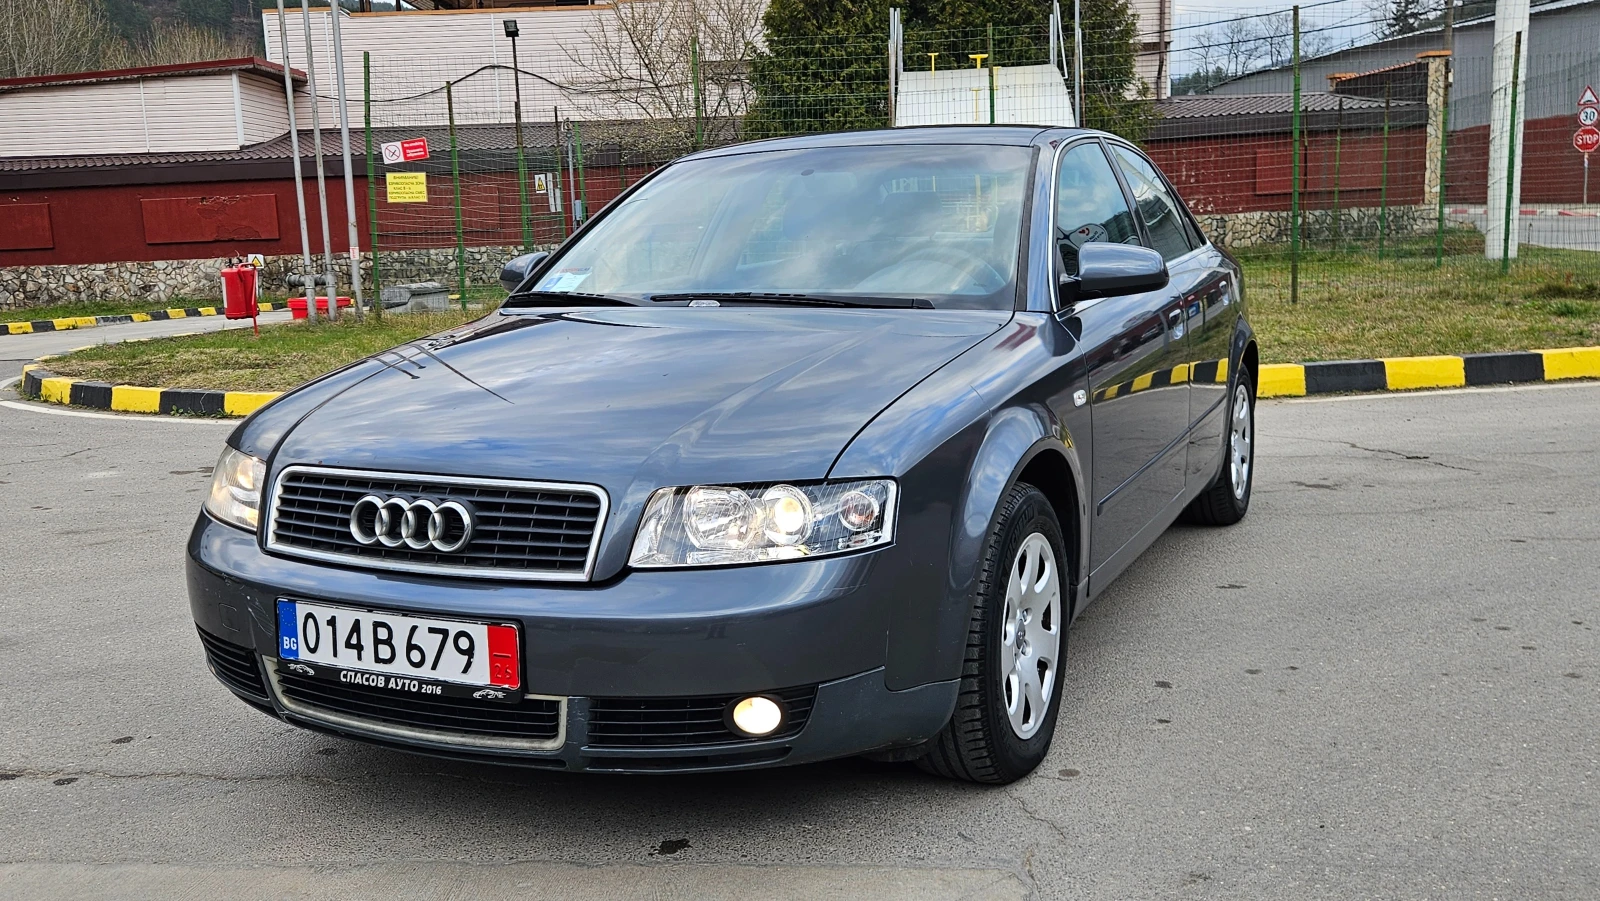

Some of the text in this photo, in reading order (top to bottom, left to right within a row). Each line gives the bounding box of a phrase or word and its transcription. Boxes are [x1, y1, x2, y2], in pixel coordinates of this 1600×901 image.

[1583, 110, 1596, 122] 30
[1576, 134, 1599, 145] STOP
[283, 636, 297, 650] BG
[340, 671, 442, 695] СПАСОВ АУТО 2016
